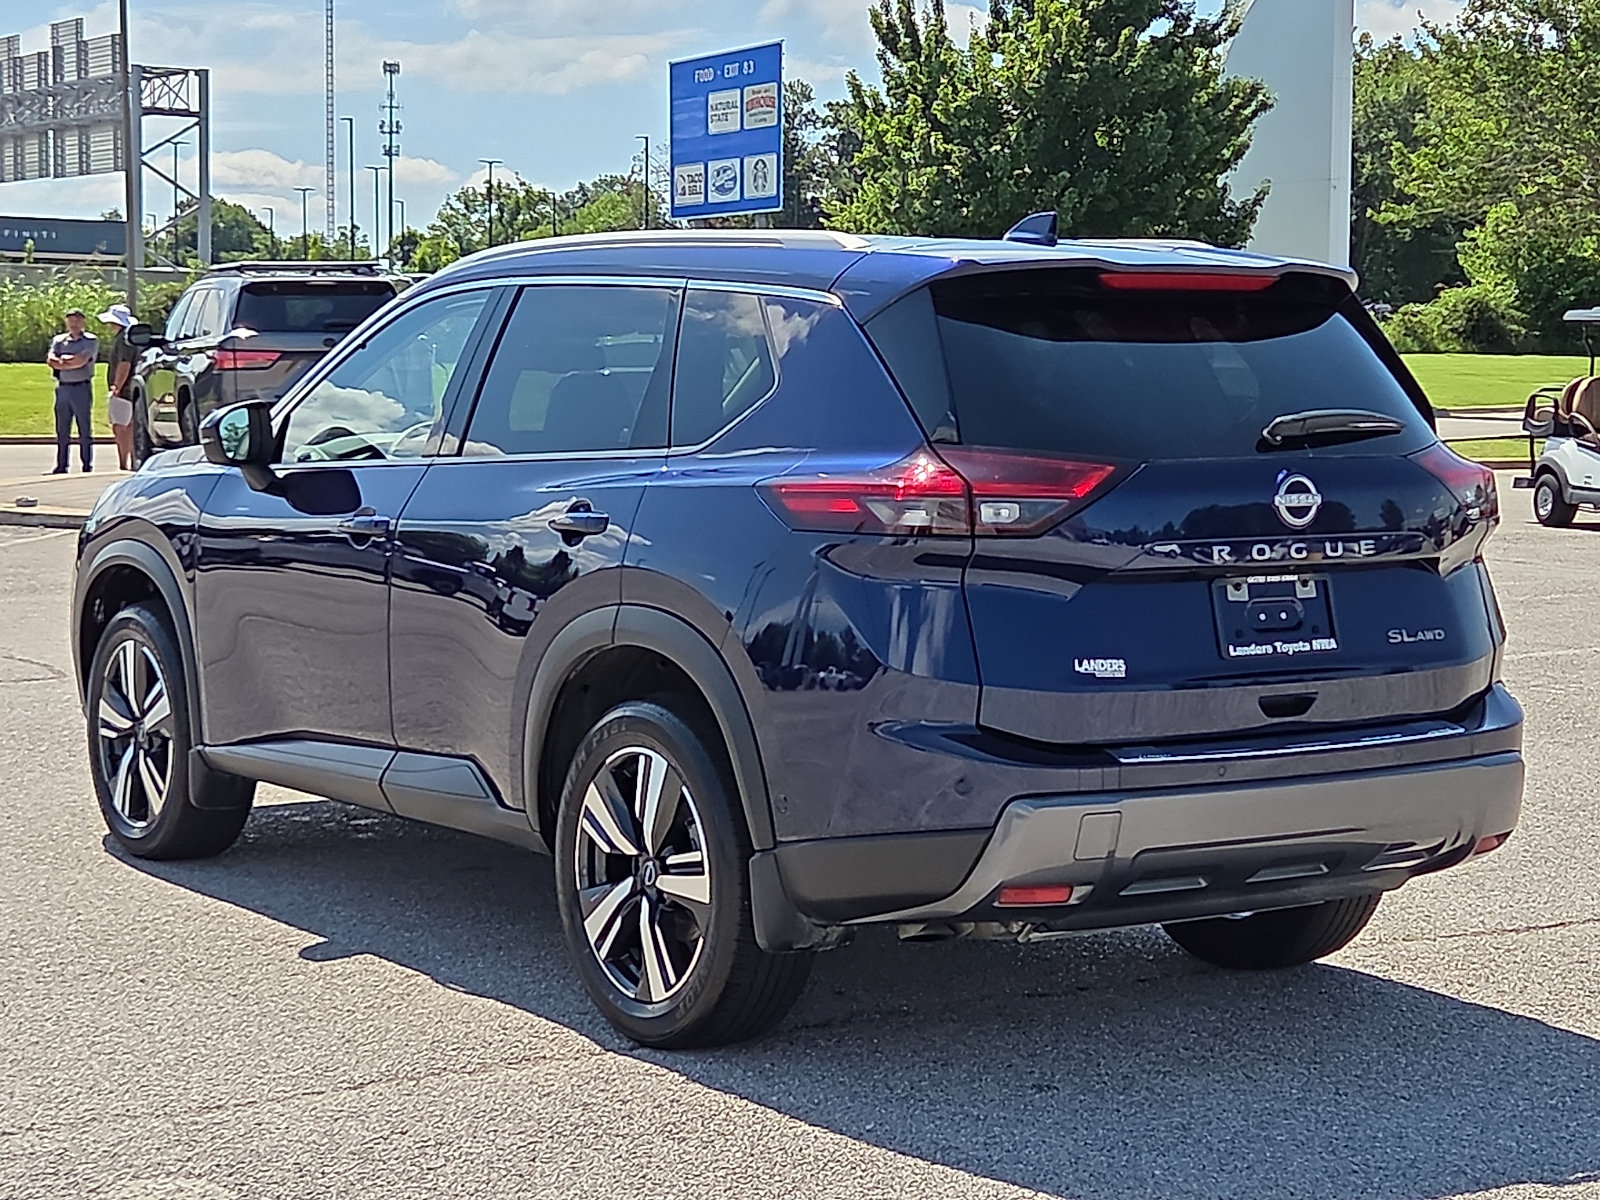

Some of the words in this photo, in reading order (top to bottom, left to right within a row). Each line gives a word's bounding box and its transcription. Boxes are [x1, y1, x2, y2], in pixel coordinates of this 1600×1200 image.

[710, 100, 739, 112] NATURAL
[710, 112, 729, 124] STATE
[687, 173, 703, 184] TACO
[688, 185, 703, 195] BELL
[1275, 494, 1322, 506] NISSAN
[1212, 540, 1377, 563] ROGUE
[1388, 629, 1416, 643] SL
[1416, 629, 1446, 641] AWD
[1229, 644, 1274, 657] Landers
[1273, 640, 1311, 655] Toyota
[1074, 659, 1126, 672] LANDERS
